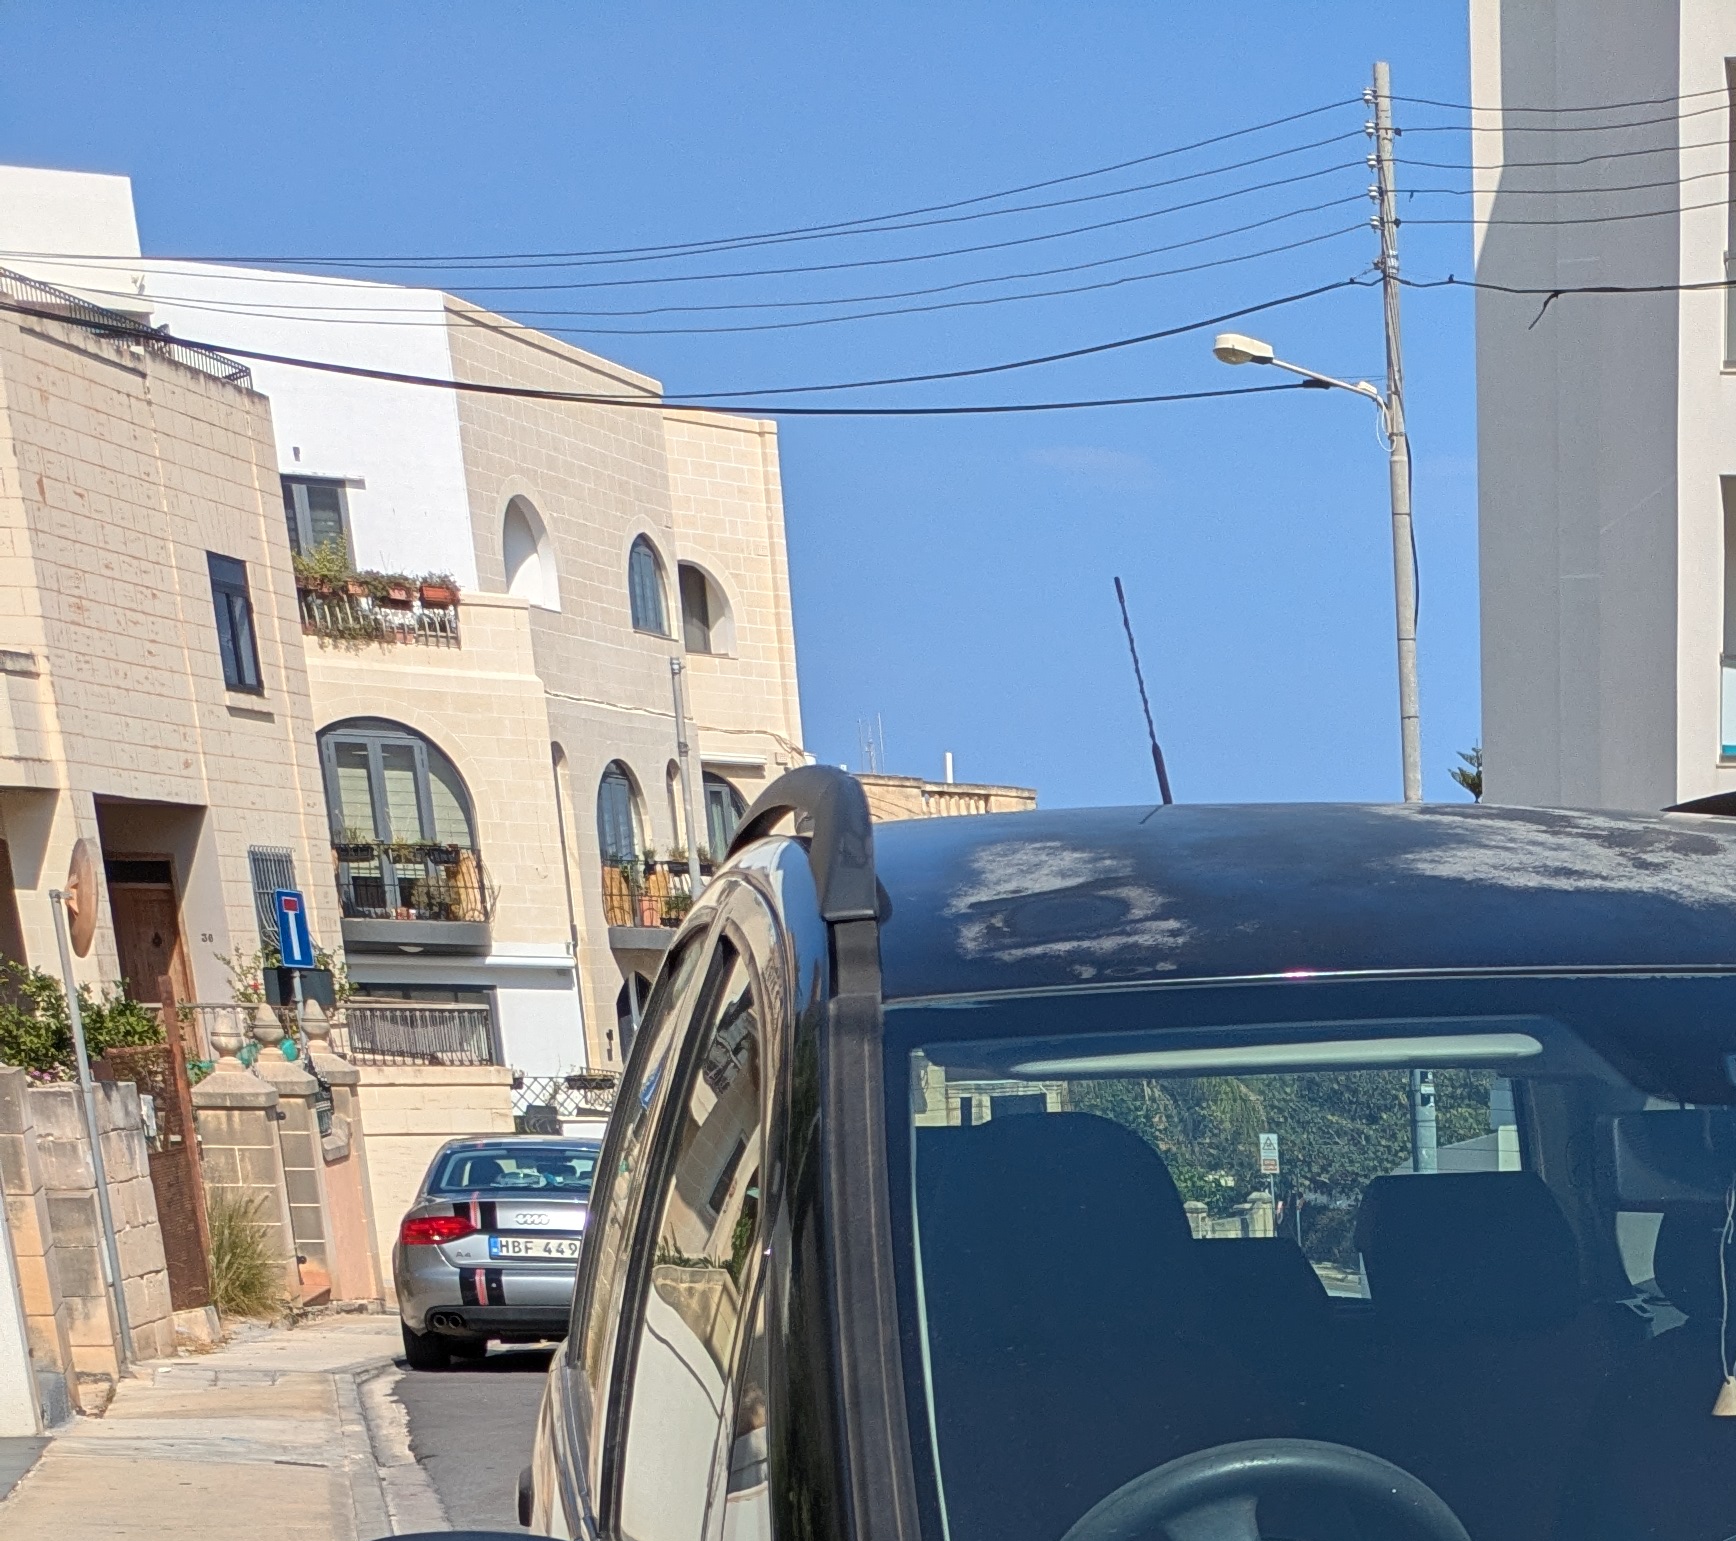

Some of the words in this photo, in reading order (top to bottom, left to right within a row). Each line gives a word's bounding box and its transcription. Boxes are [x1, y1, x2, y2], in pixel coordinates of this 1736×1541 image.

[500, 1239, 534, 1255] HBF
[543, 1241, 578, 1256] 449
[455, 1251, 471, 1259] A4
